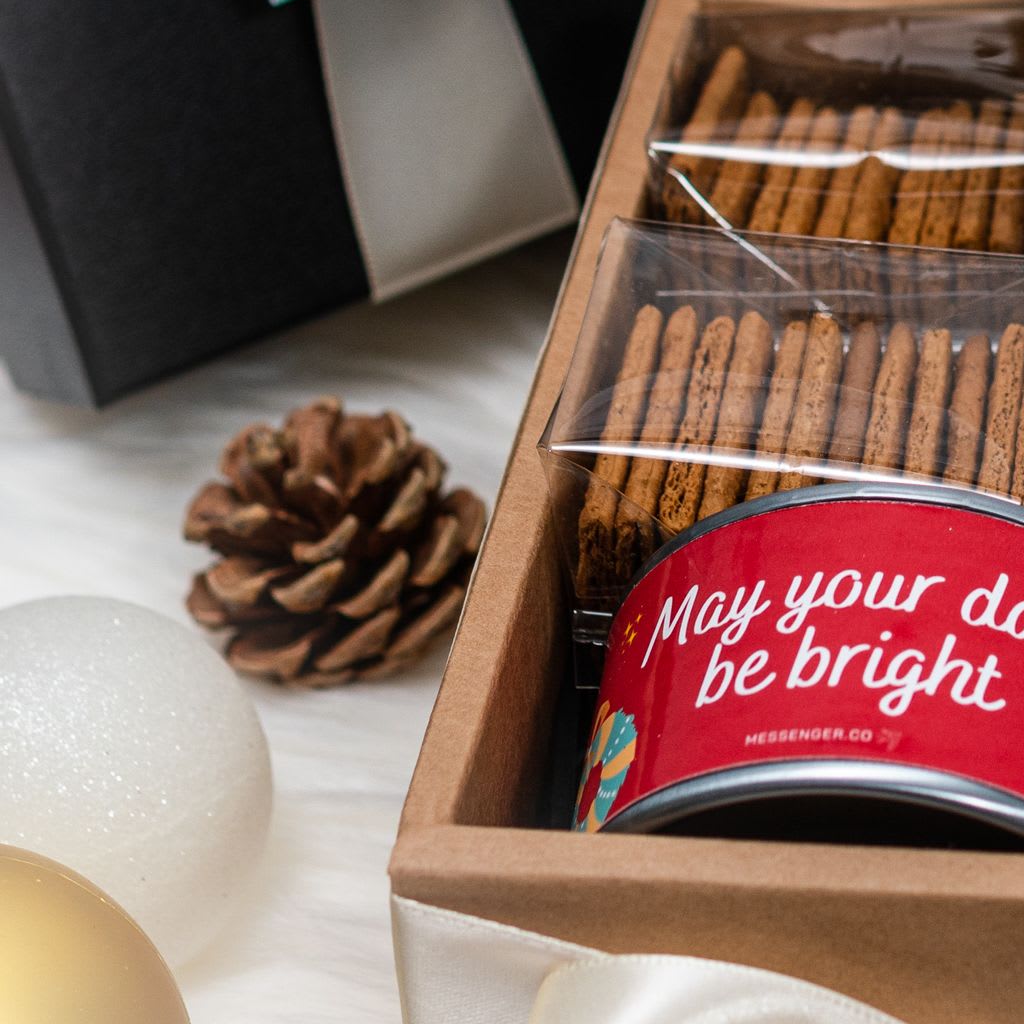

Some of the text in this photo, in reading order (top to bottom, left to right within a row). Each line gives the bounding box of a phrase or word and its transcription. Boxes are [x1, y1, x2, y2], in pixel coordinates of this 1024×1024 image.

[640, 579, 771, 668] May
[776, 569, 946, 636] your
[694, 625, 1007, 717] be bright
[744, 727, 873, 746] MESSENGER.CO
